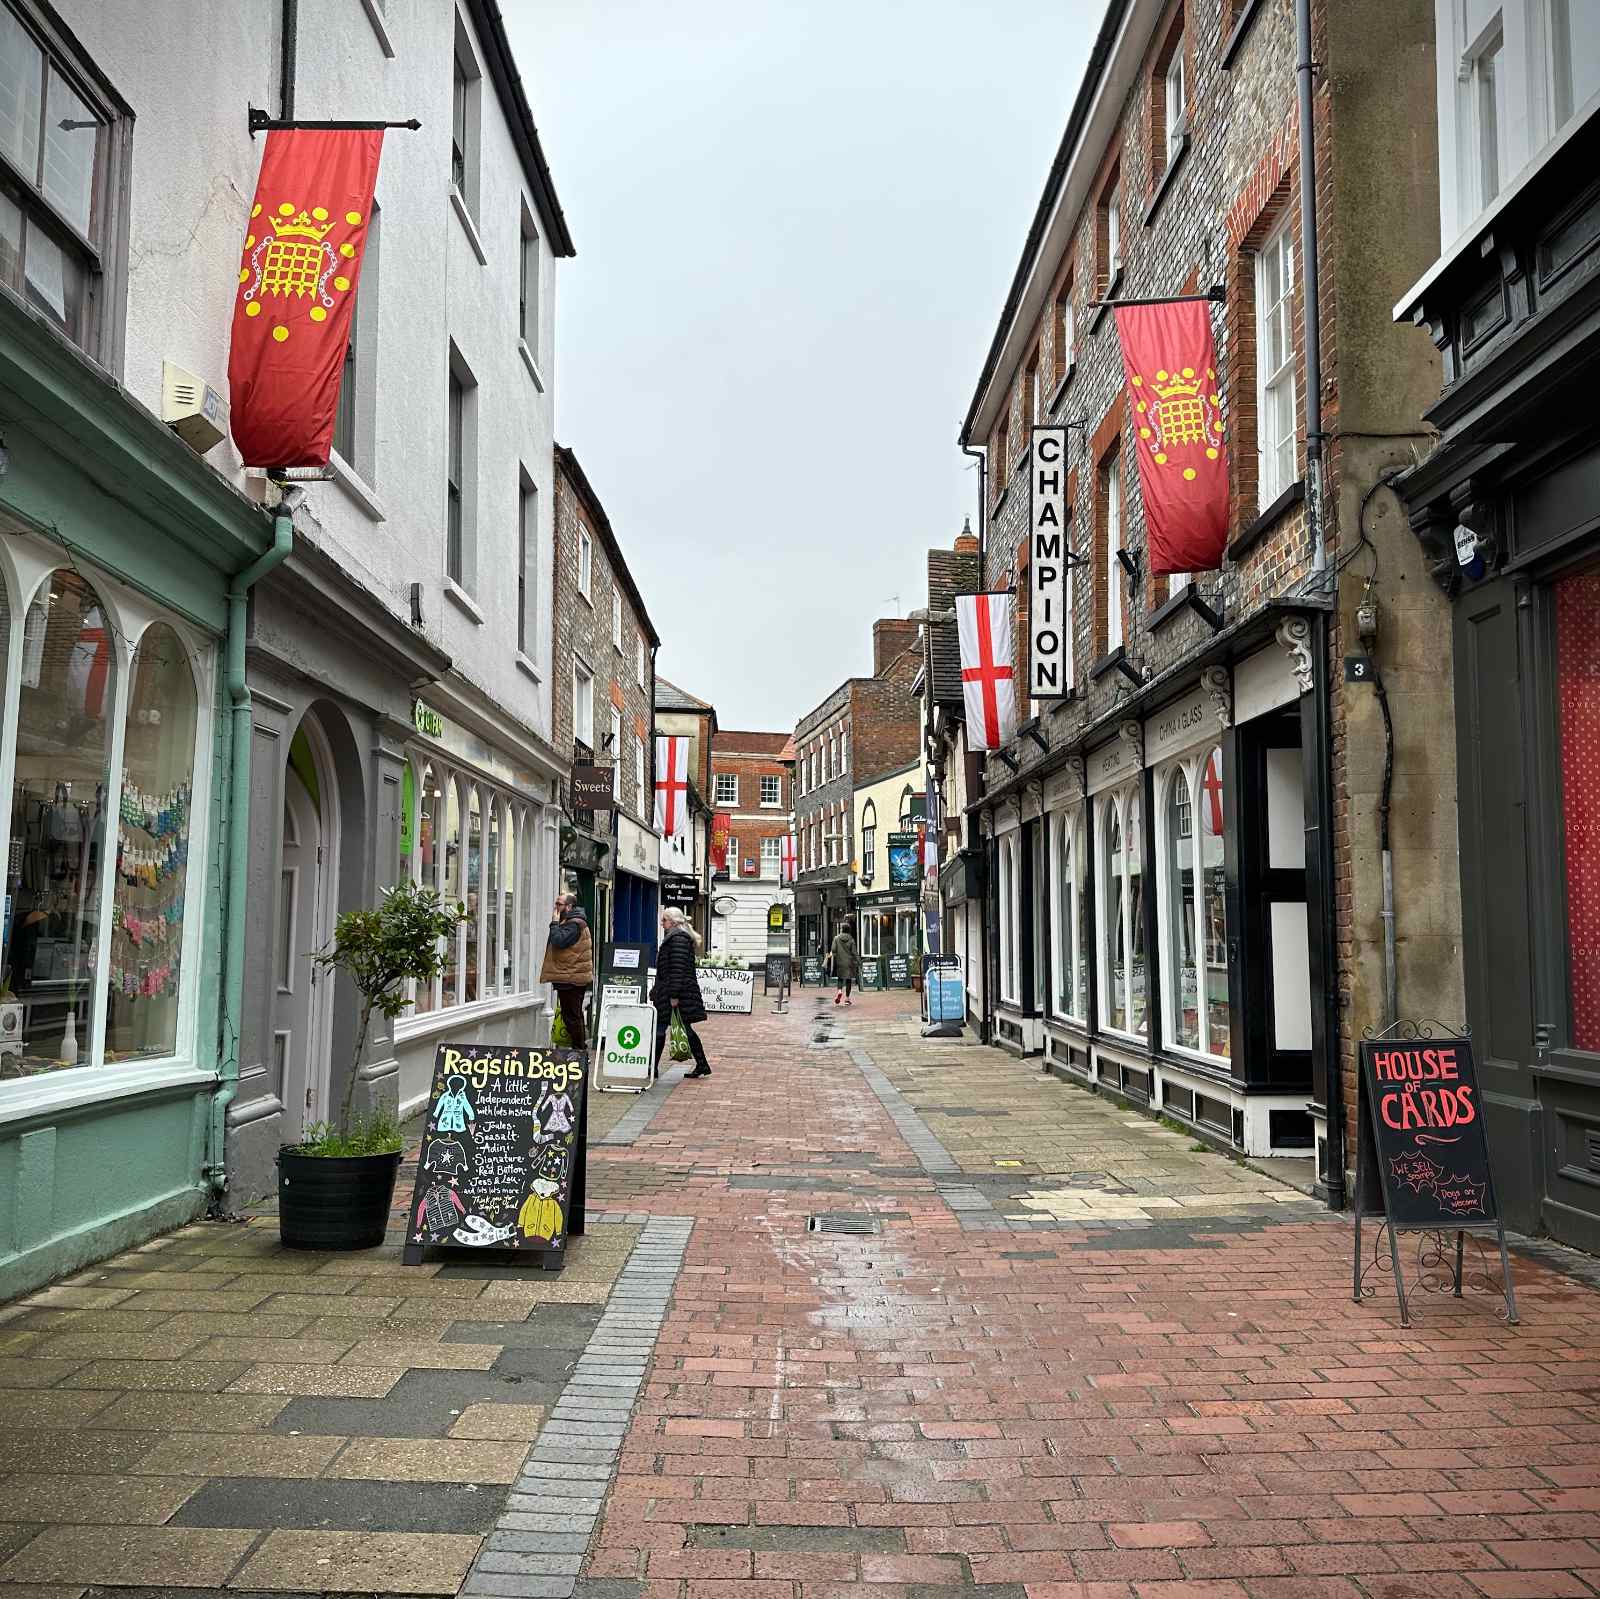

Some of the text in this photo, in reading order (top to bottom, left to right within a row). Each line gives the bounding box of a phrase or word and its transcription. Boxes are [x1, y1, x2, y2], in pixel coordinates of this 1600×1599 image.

[1036, 437, 1061, 688] CHAMPION
[1354, 663, 1364, 676] 3
[1159, 719, 1178, 741] CHINA
[1181, 703, 1203, 730] GLASS
[574, 779, 612, 794] Sweets
[680, 882, 696, 890] House
[696, 970, 718, 979] EAN
[723, 969, 753, 984] BREW
[700, 986, 744, 996] offee House
[719, 1002, 745, 1010] Rooms
[607, 1051, 647, 1065] Oxfam
[1374, 1049, 1459, 1081] HOUSE
[443, 1050, 583, 1091] Rags in Bags
[490, 1077, 530, 1093] A little
[1405, 1080, 1421, 1093] OF
[475, 1090, 532, 1107] Independent
[477, 1105, 532, 1117] with lots in store
[1381, 1085, 1476, 1130] CARDS
[482, 1121, 513, 1133] Joules
[474, 1130, 518, 1144] Seasalt
[479, 1143, 510, 1154] Adini
[475, 1153, 524, 1170] Signature
[479, 1164, 526, 1177] Red Button
[470, 1174, 519, 1187] Jess & Lou
